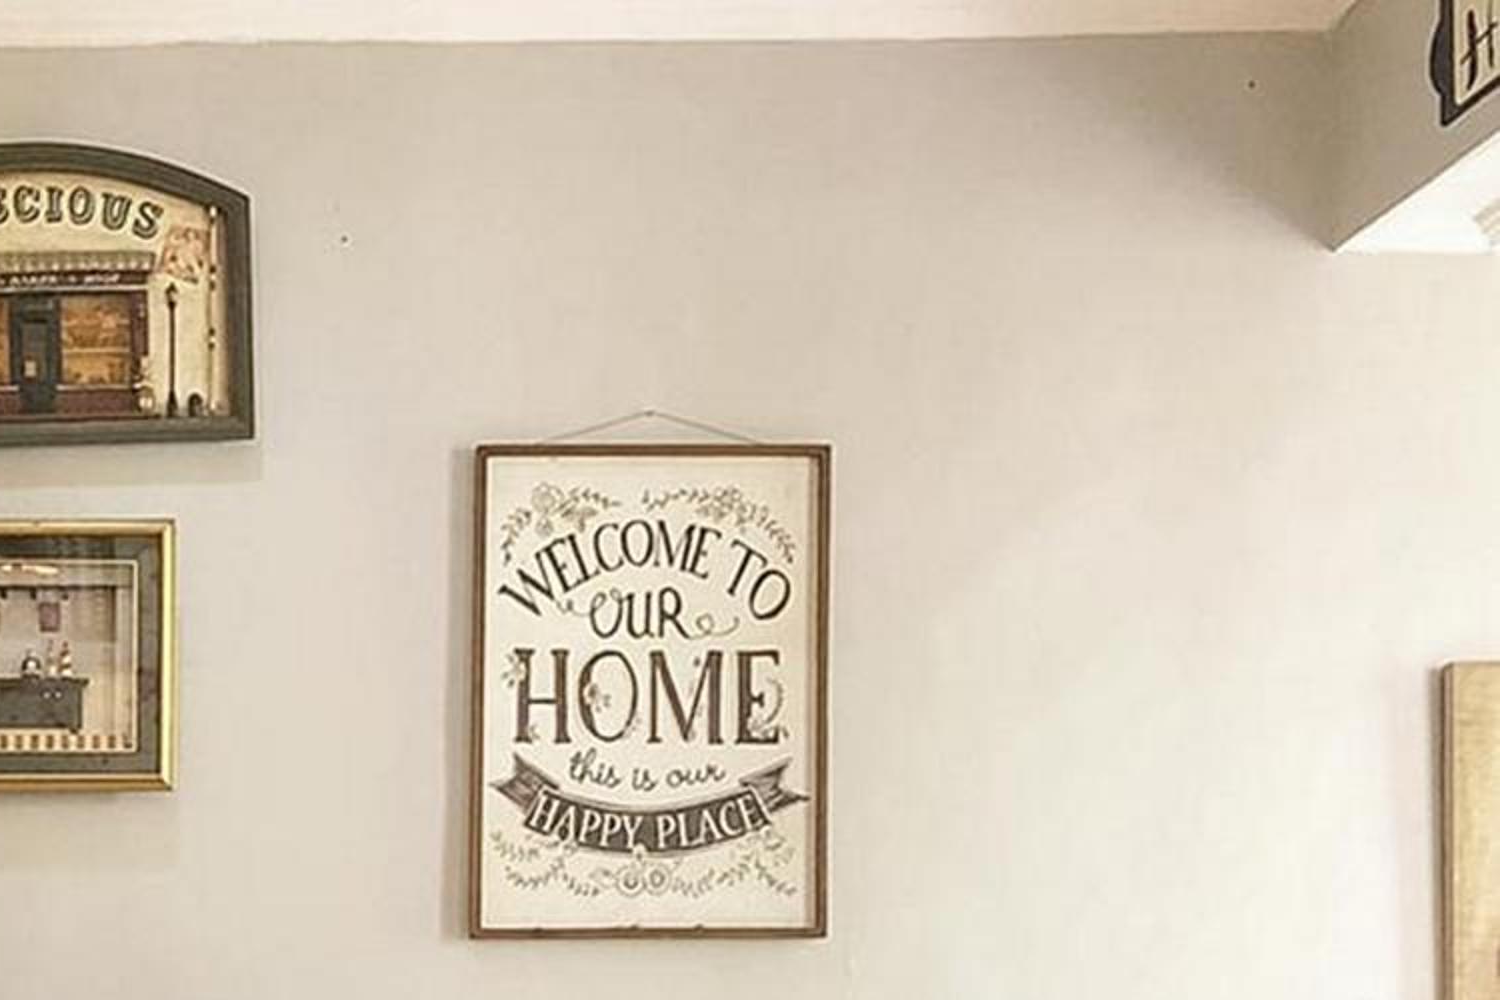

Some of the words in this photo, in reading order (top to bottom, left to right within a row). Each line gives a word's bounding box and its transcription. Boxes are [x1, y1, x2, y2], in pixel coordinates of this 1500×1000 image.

[497, 519, 723, 617] WELCOME
[725, 539, 792, 621] TO
[586, 586, 693, 639] OUR
[513, 648, 784, 745] HOME
[568, 748, 621, 789] this
[631, 767, 658, 791] is
[665, 762, 726, 788] our
[529, 794, 644, 849] HAPPY
[656, 793, 764, 848] PLACE
